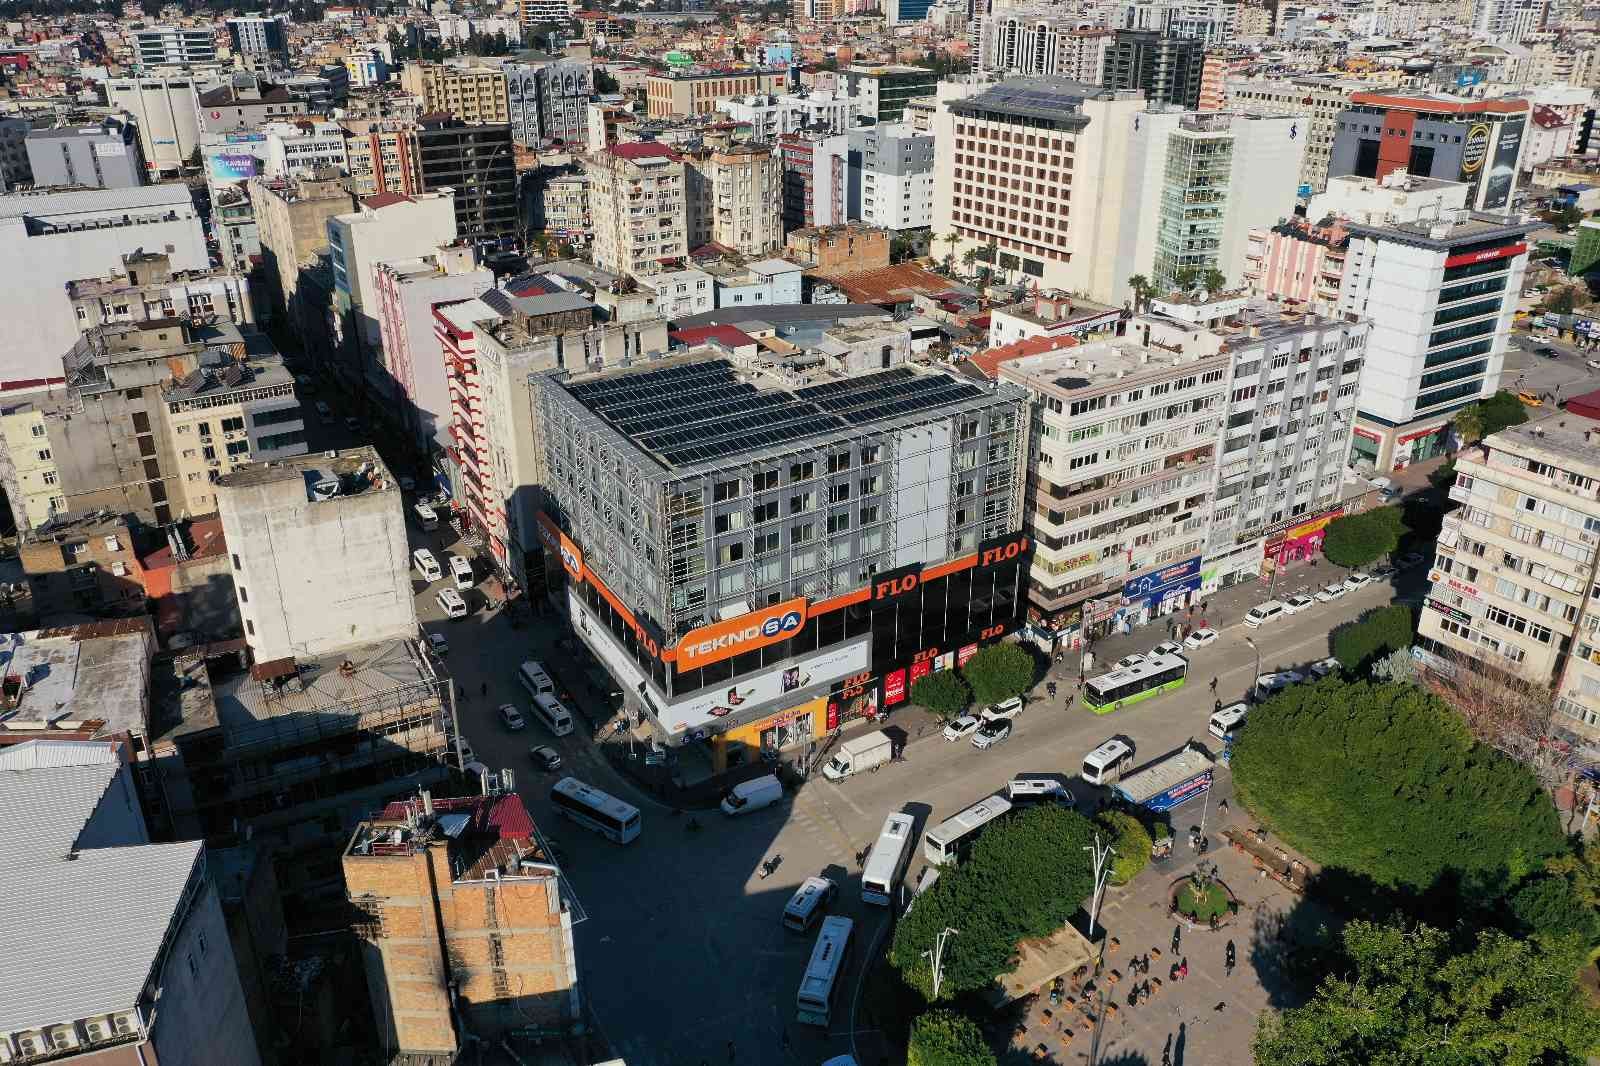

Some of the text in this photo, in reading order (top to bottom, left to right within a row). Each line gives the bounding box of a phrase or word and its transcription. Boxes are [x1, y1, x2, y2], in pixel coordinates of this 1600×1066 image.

[981, 541, 1019, 567] FLO
[876, 574, 917, 600] FLO
[636, 623, 658, 657] FLO
[685, 613, 801, 658] TEKNOSA
[981, 624, 1004, 640] FLO
[914, 648, 938, 663] FLO
[843, 672, 870, 689] FLO
[842, 686, 864, 700] FLO
